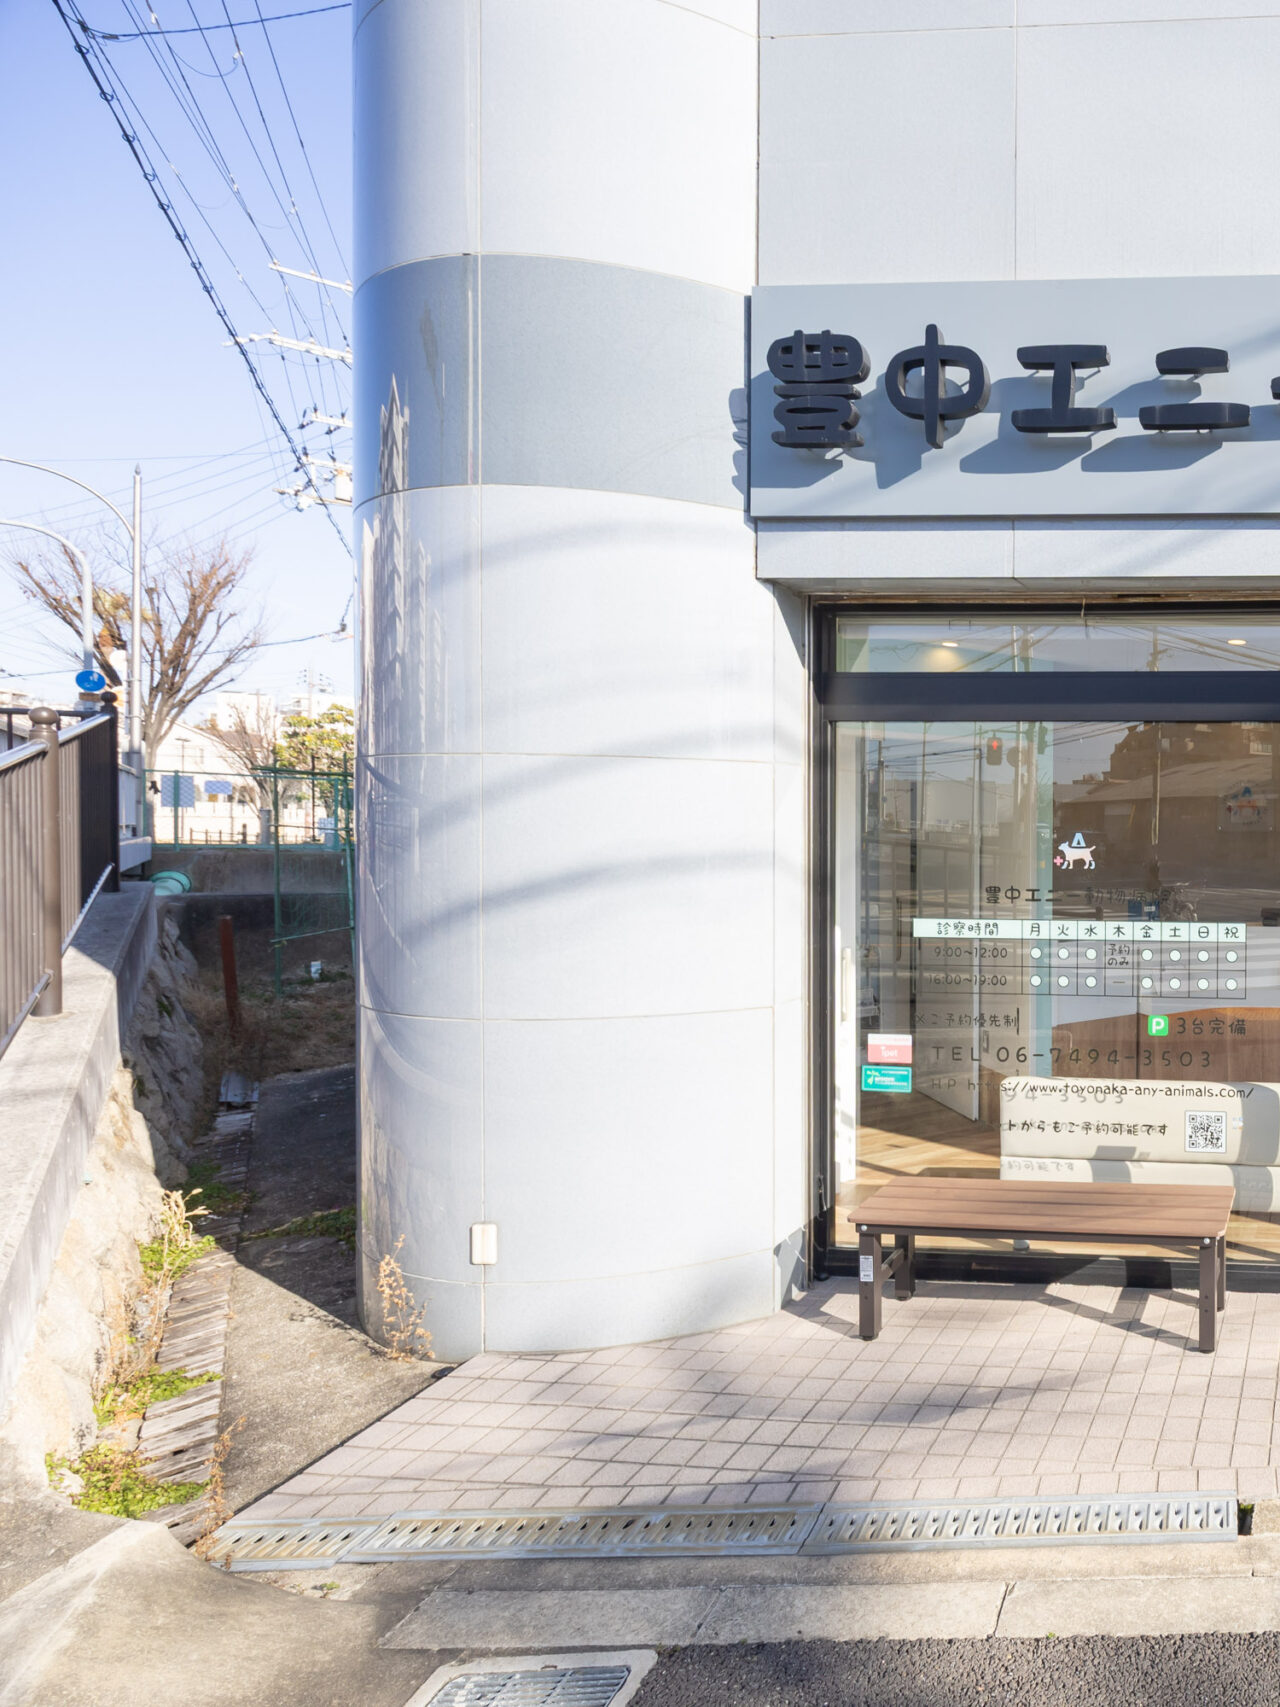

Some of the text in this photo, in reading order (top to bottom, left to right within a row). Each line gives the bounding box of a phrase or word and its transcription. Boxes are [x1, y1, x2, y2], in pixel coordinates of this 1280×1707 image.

[936, 921, 999, 936] 診察時間
[1029, 922, 1041, 937] 月
[1057, 924, 1069, 937] 火
[1084, 924, 1098, 937] 水
[1112, 925, 1126, 938] 木
[1140, 925, 1153, 938] 金
[1198, 926, 1209, 939] 日
[1224, 926, 1239, 939] 祝
[1108, 943, 1130, 956] 予約
[1107, 957, 1129, 967] のみ
[1176, 1016, 1247, 1036] 3台完備
[932, 1046, 1211, 1068] TEL 06-7494-3503
